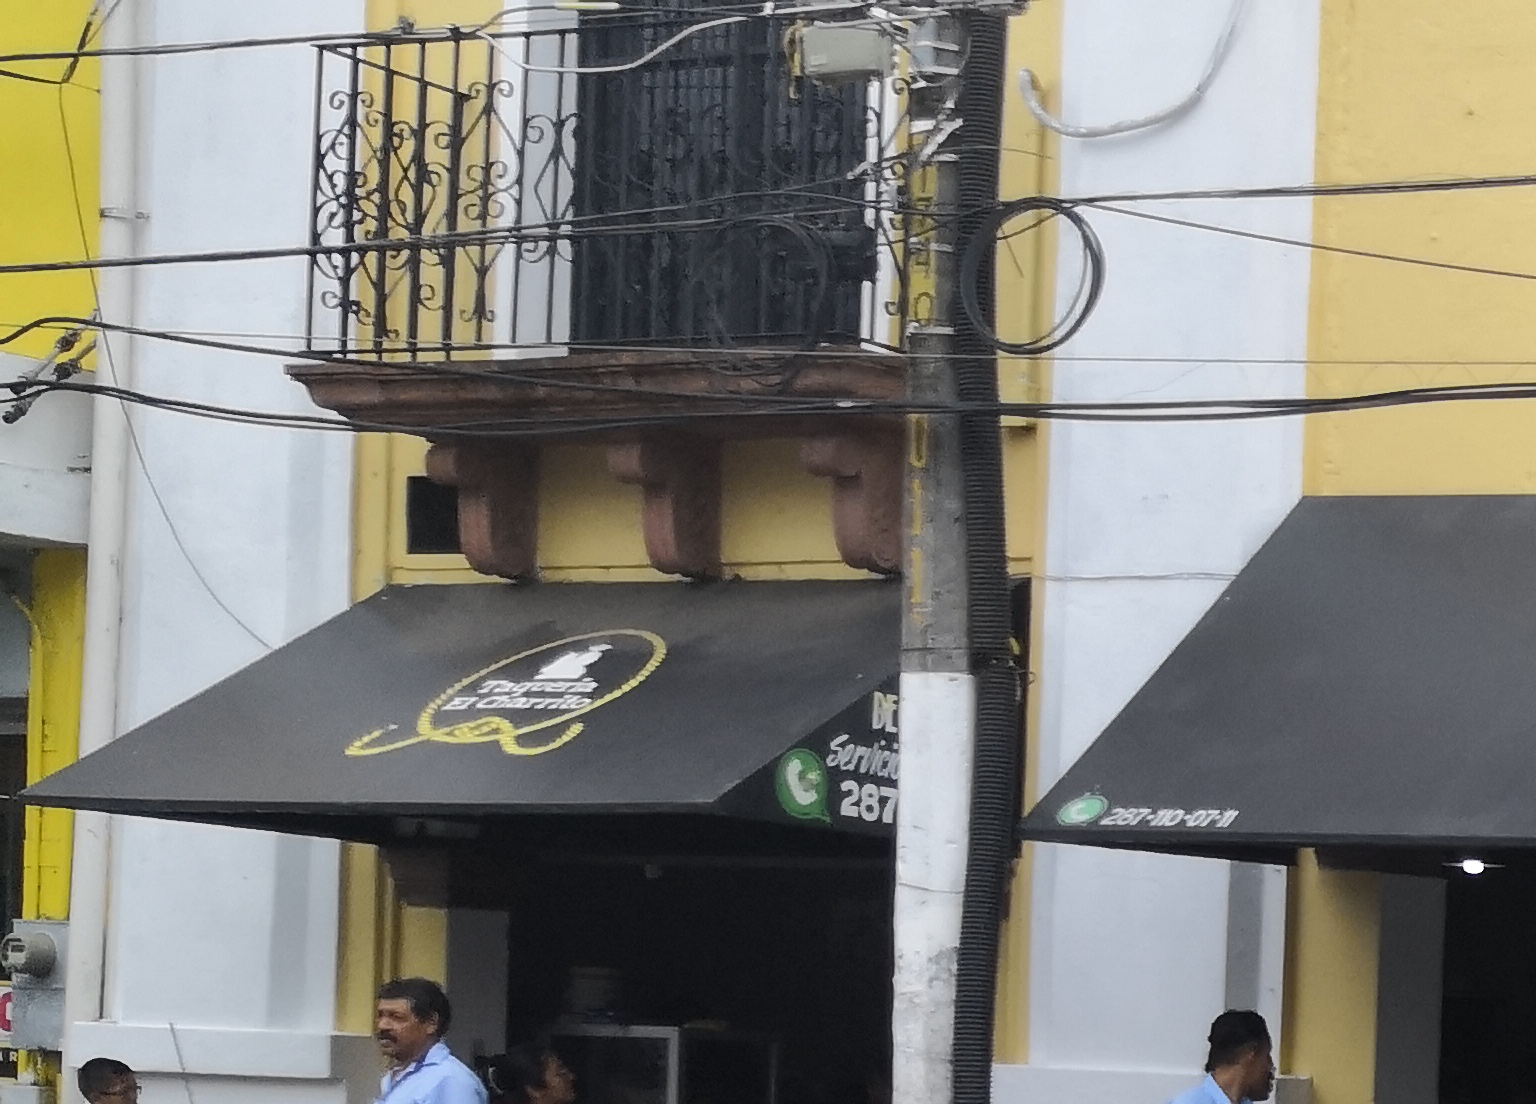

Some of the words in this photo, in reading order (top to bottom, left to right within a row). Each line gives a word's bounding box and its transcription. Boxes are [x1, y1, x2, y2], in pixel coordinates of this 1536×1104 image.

[477, 677, 599, 697] Taqueria
[441, 697, 479, 711] El
[475, 693, 592, 710] Charrito
